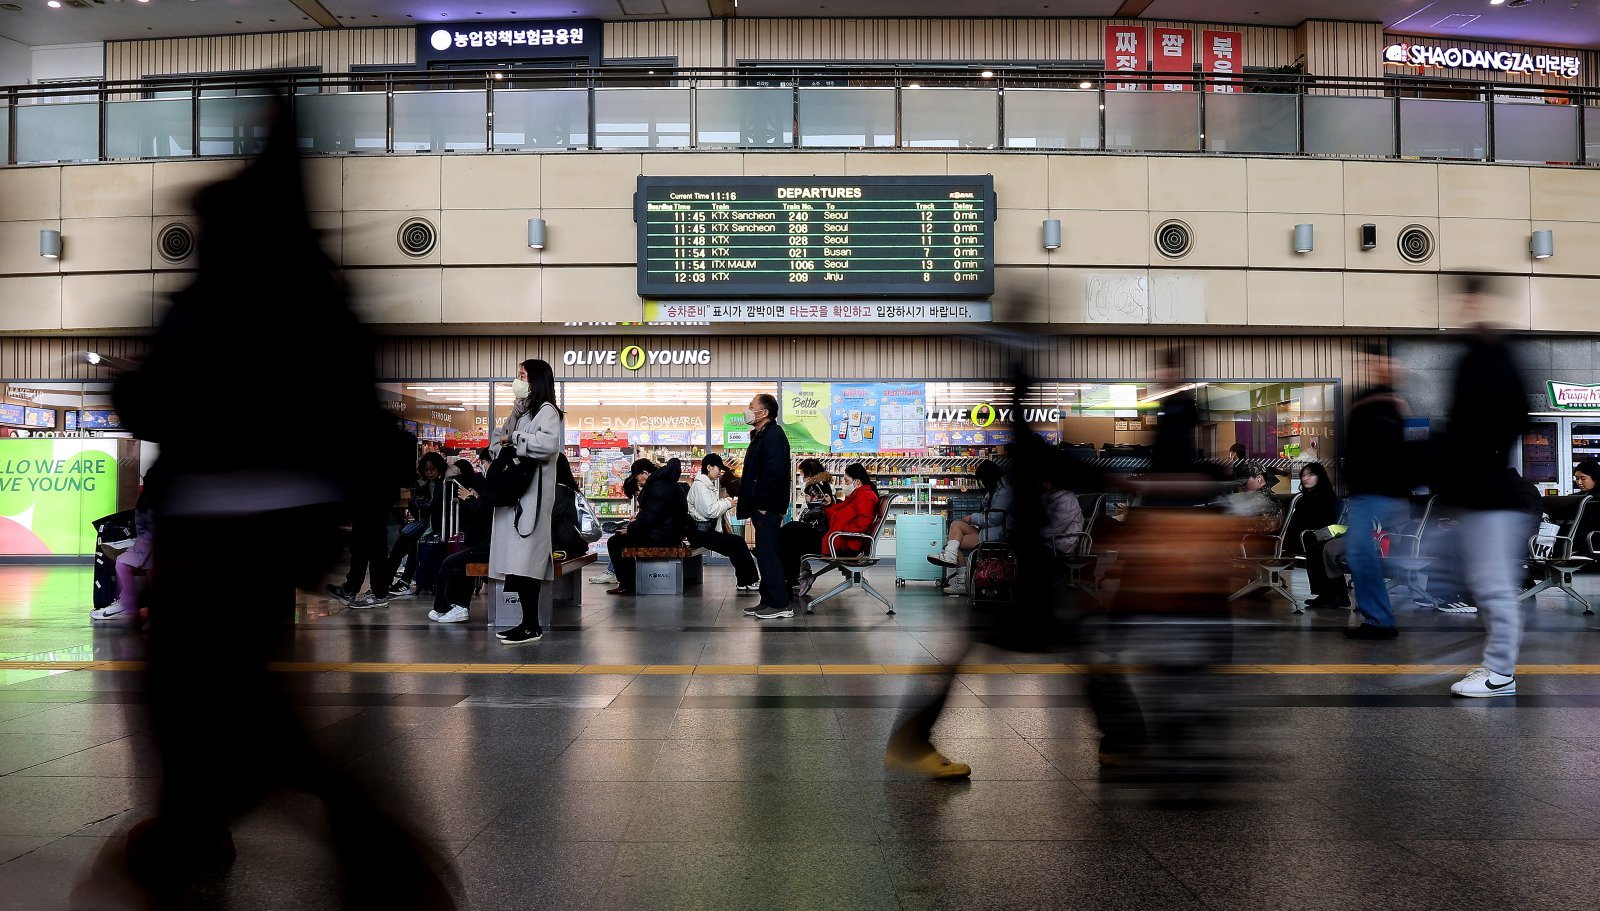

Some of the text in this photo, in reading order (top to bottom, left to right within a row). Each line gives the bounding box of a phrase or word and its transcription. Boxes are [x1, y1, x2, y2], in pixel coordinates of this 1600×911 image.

[453, 28, 583, 48] 농업정책보험금융원
[1410, 44, 1532, 72] SHAODANGZA
[1535, 54, 1581, 77] 마라탕
[669, 191, 737, 201] Current Time 11:16
[777, 188, 862, 199] DEPARTURES
[953, 203, 974, 211] Delay
[674, 212, 706, 221] 11:45
[711, 212, 776, 220] KTX Sancheon
[788, 212, 809, 221] 240
[823, 211, 849, 220] Seoul
[920, 212, 933, 221] 12
[953, 211, 978, 221] 0 min
[674, 224, 706, 233] 11:45
[711, 224, 776, 232] KTX Sancheon
[788, 224, 809, 233] 208
[823, 223, 849, 232] Seoul
[920, 224, 933, 233] 12
[953, 223, 978, 233] 0 min
[674, 236, 706, 245] 11:48
[711, 236, 730, 244] KTX
[788, 236, 809, 245] 028
[823, 235, 849, 244] Seoul
[920, 236, 932, 245] 11
[953, 235, 978, 245] 0 min
[674, 249, 706, 258] 11:54
[711, 249, 730, 257] KTX
[788, 249, 809, 258] 021
[823, 247, 851, 256] Busan
[923, 248, 930, 257] 7
[953, 247, 978, 257] 0 min
[674, 261, 706, 270] 11:54
[711, 261, 757, 269] ITX MAUM
[789, 261, 814, 270] 1006
[823, 259, 849, 268] Seoul
[920, 260, 933, 269] 13
[953, 259, 978, 269] 0 min
[674, 273, 706, 282] 12:03
[711, 273, 730, 281] KTX
[788, 273, 809, 282] 209
[823, 272, 844, 282] Jinju
[923, 272, 930, 282] 8
[953, 272, 978, 282] 0 min
[712, 305, 742, 318] 표시가
[746, 305, 785, 318] 깜박이면
[789, 305, 829, 318] 타는곳을
[832, 305, 872, 318] 확인하고
[876, 305, 926, 318] 입장하시기
[929, 305, 972, 318] 바랍니다.
[563, 350, 617, 365] OLIVE
[648, 350, 711, 365] YOUNG
[791, 396, 821, 409] Better
[998, 408, 1060, 422] YUNG
[35, 459, 66, 474] WE
[69, 459, 106, 474] ARE
[28, 477, 95, 491] YOUNG
